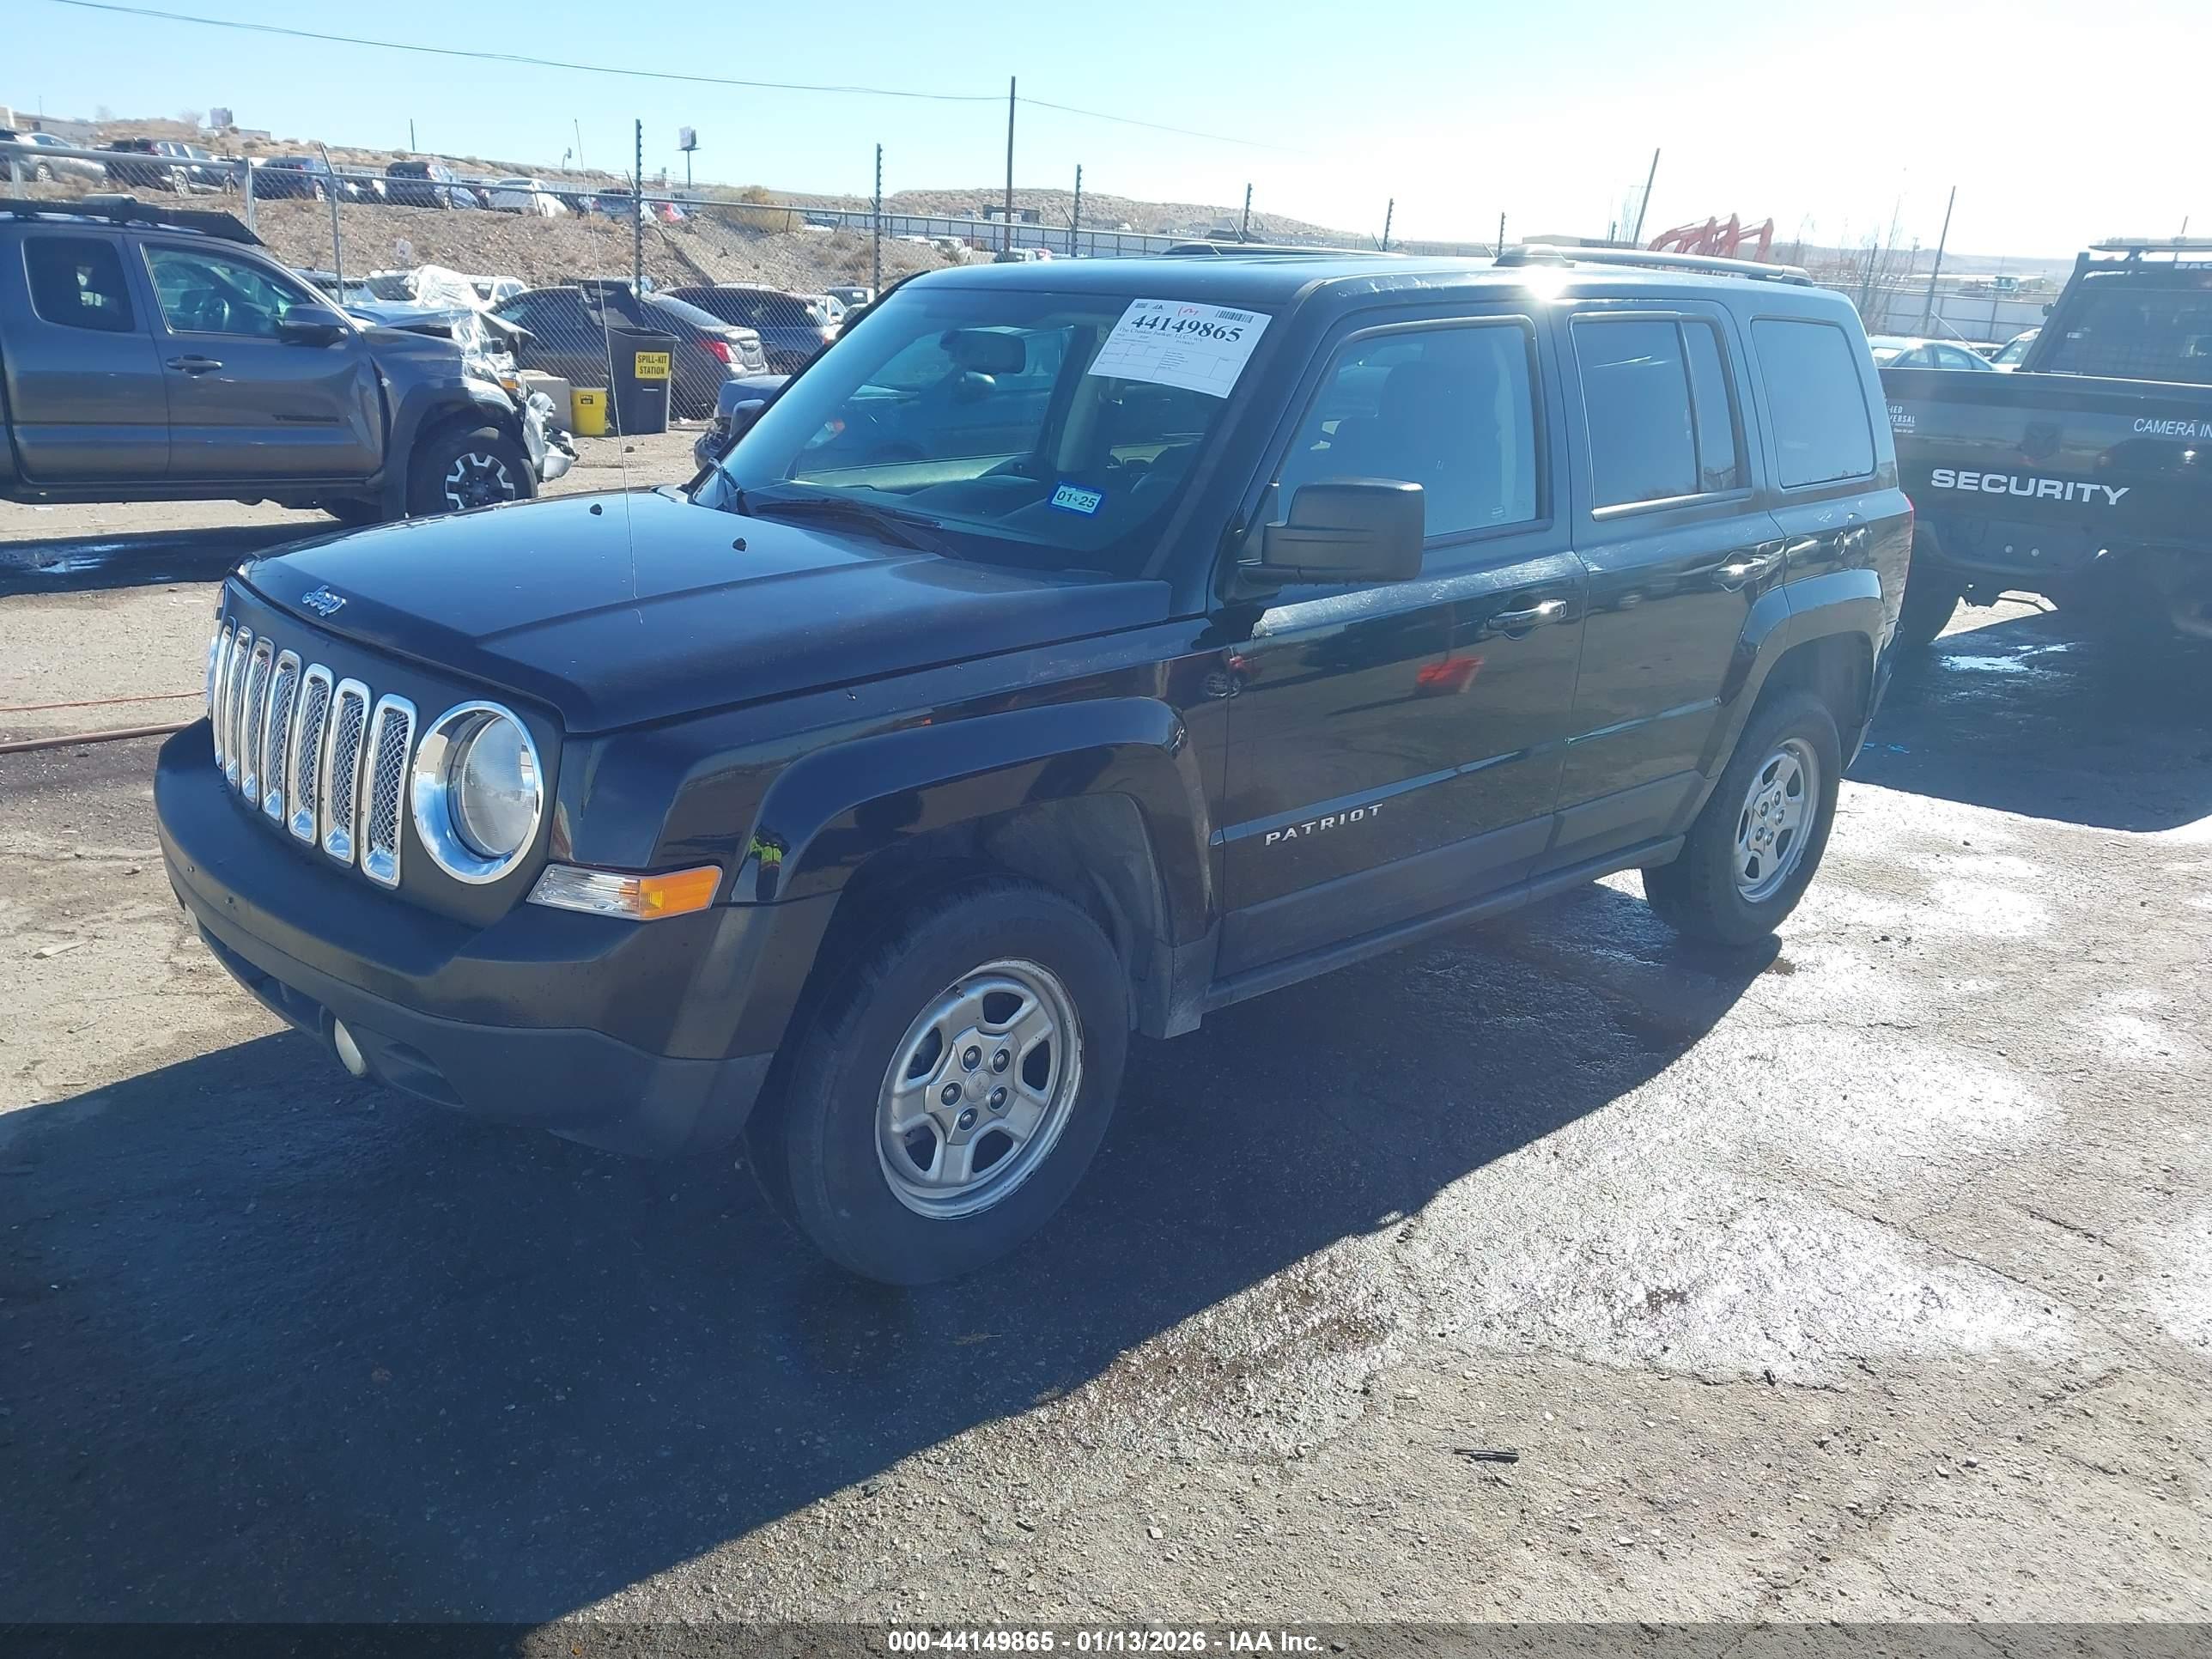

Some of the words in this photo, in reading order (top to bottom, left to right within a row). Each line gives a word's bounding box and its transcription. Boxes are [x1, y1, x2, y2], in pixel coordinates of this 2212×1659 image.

[1131, 314, 1244, 343] 44149865
[637, 355, 667, 364] SPILL-KIT
[639, 366, 665, 374] STATION
[2133, 418, 2196, 437] CAMERA
[1931, 469, 2130, 505] SECURITY
[302, 585, 346, 617] Jeep
[1265, 803, 1383, 846] PATRIOT
